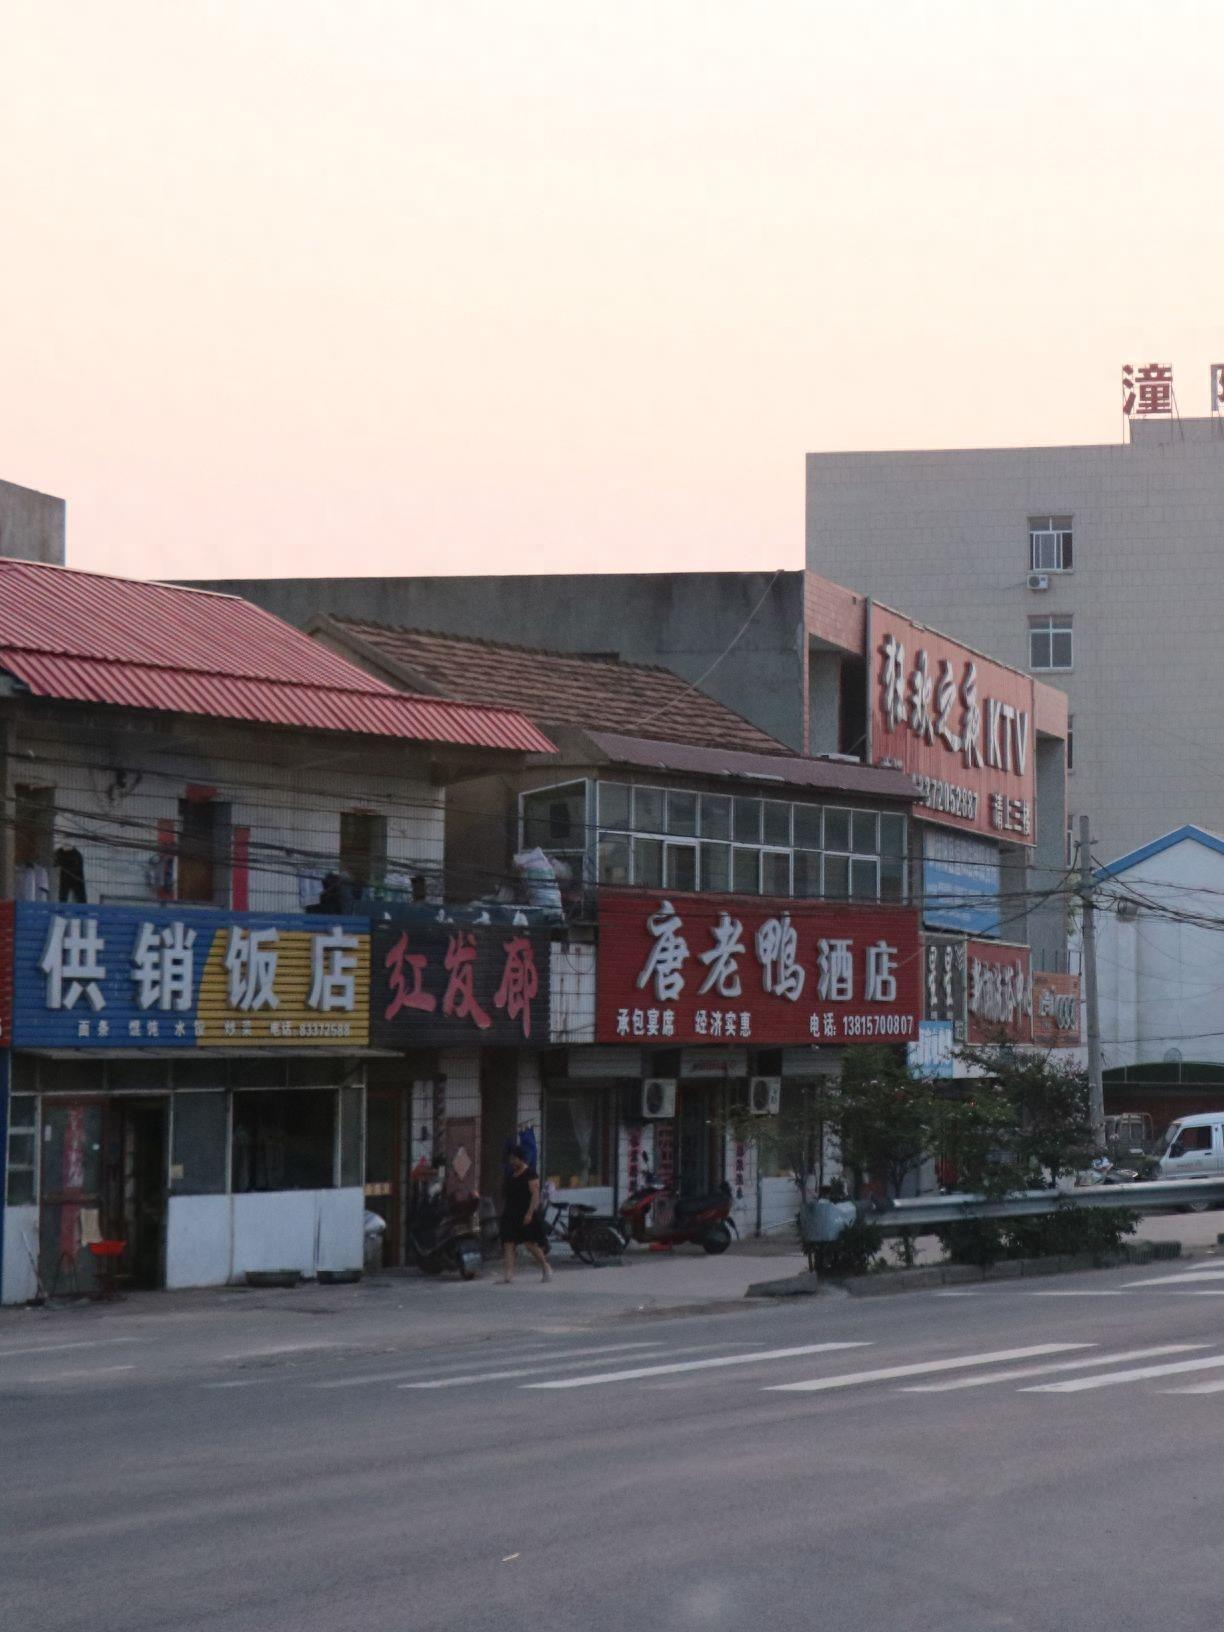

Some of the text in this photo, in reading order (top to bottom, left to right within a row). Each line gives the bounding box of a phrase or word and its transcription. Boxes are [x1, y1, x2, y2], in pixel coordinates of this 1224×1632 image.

[40, 916, 359, 1012] 供销饭店
[636, 901, 899, 1002] 唐老鸭酒店
[616, 1008, 675, 1036] 承包宴席
[694, 1009, 752, 1037] 经济实惠
